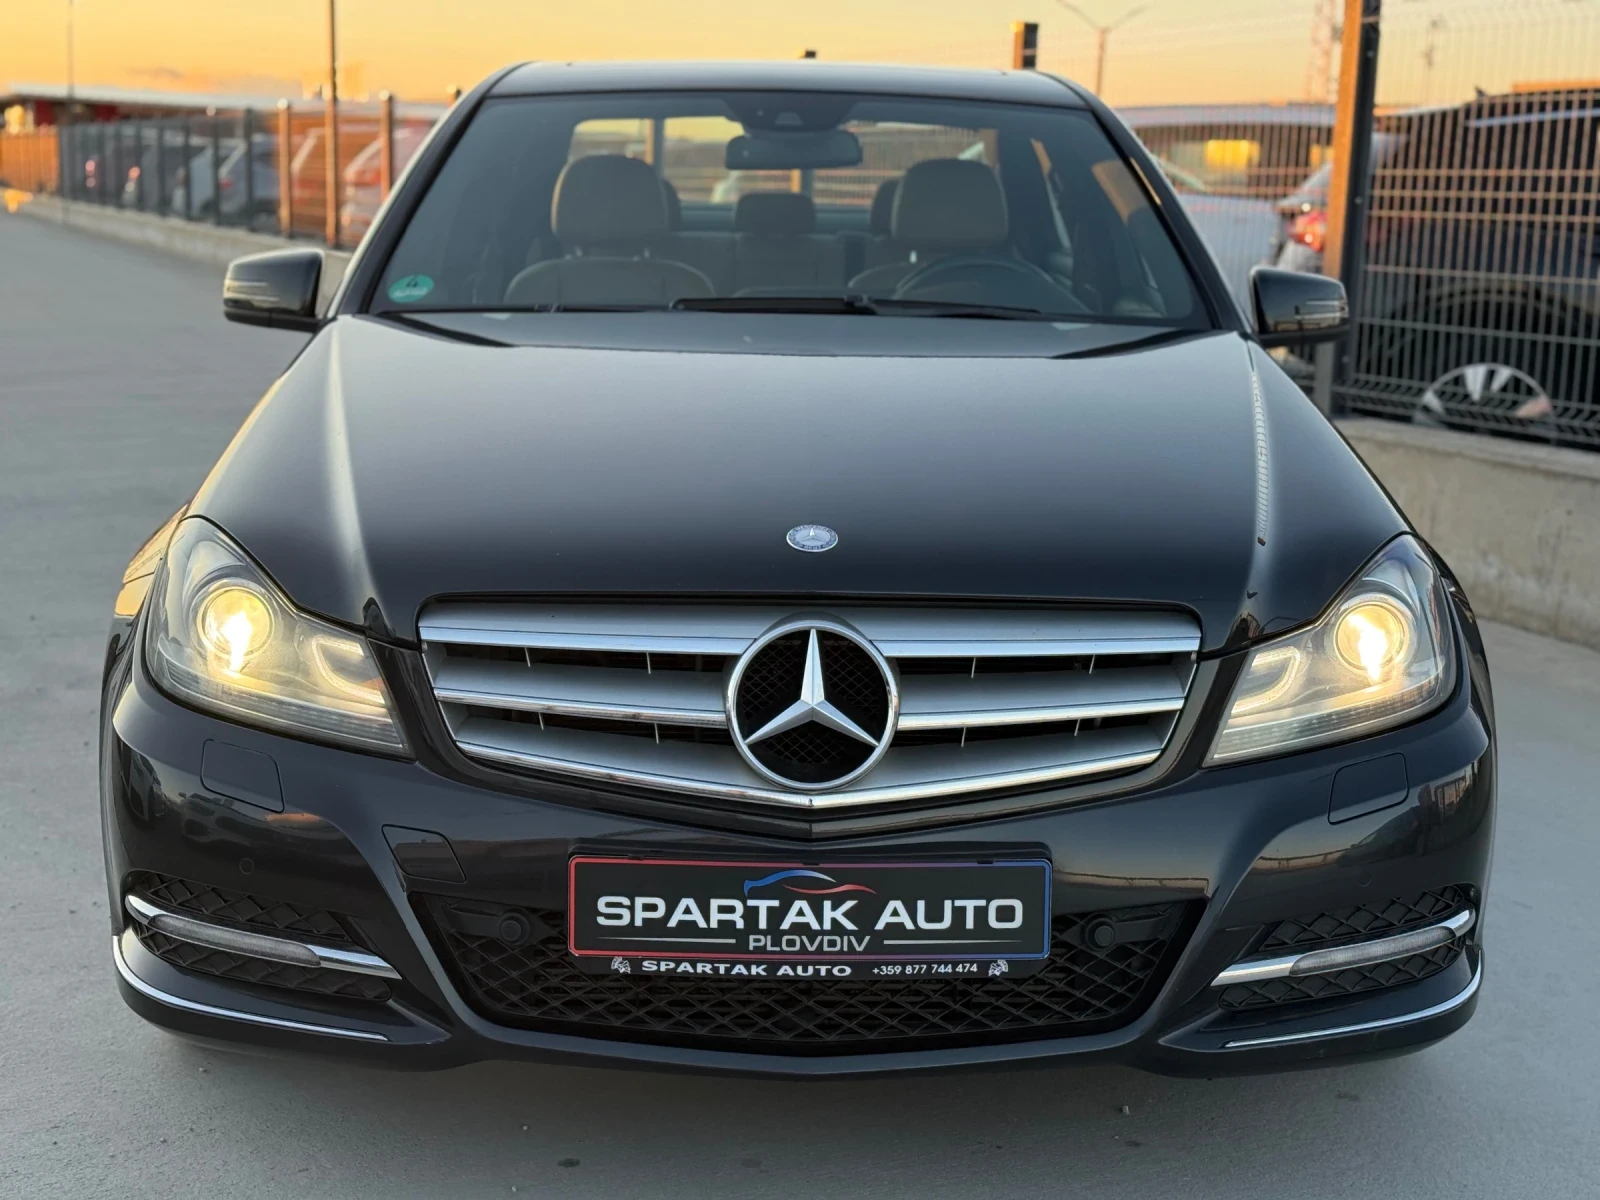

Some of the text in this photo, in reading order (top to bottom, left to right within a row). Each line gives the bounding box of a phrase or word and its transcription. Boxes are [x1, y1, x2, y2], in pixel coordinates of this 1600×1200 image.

[596, 895, 1024, 931] SPARTAK AUTO
[748, 935, 871, 952] PLOVDIV
[641, 960, 978, 977] SPARTAK AUTO +359 877 744 474
